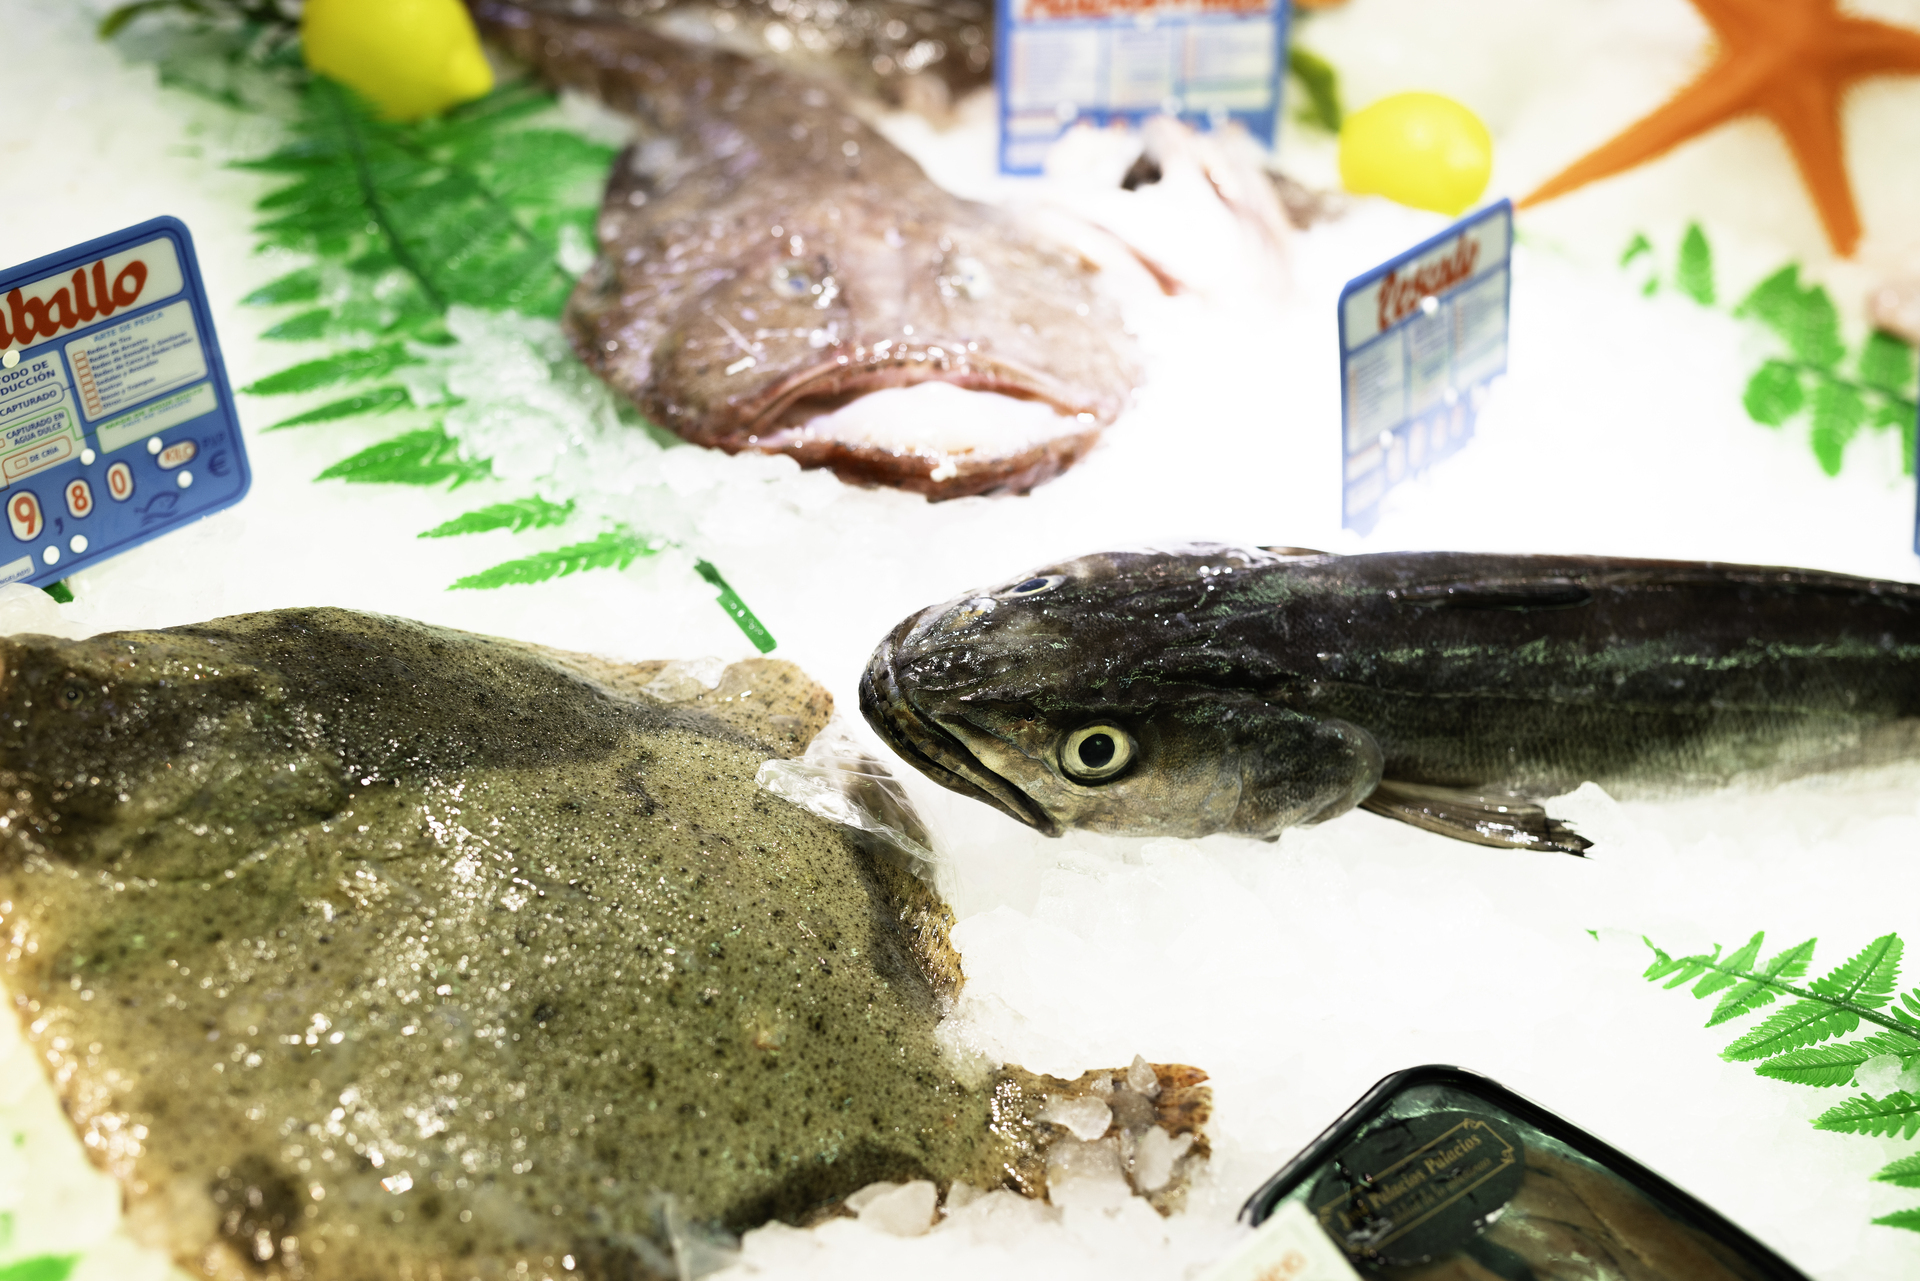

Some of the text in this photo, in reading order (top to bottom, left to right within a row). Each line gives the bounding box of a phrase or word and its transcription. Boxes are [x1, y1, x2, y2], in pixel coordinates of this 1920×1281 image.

[93, 312, 164, 341] ARTE DE PESCA
[32, 360, 49, 373] DE
[0, 389, 57, 416] CAPTURADO
[6, 411, 65, 440] CAPTURADO EN
[14, 422, 63, 446] AGUA DULCE
[29, 446, 60, 463] DE CRÍA
[1367, 1168, 1427, 1210] Palacios
[1423, 1133, 1483, 1175] Palacios
